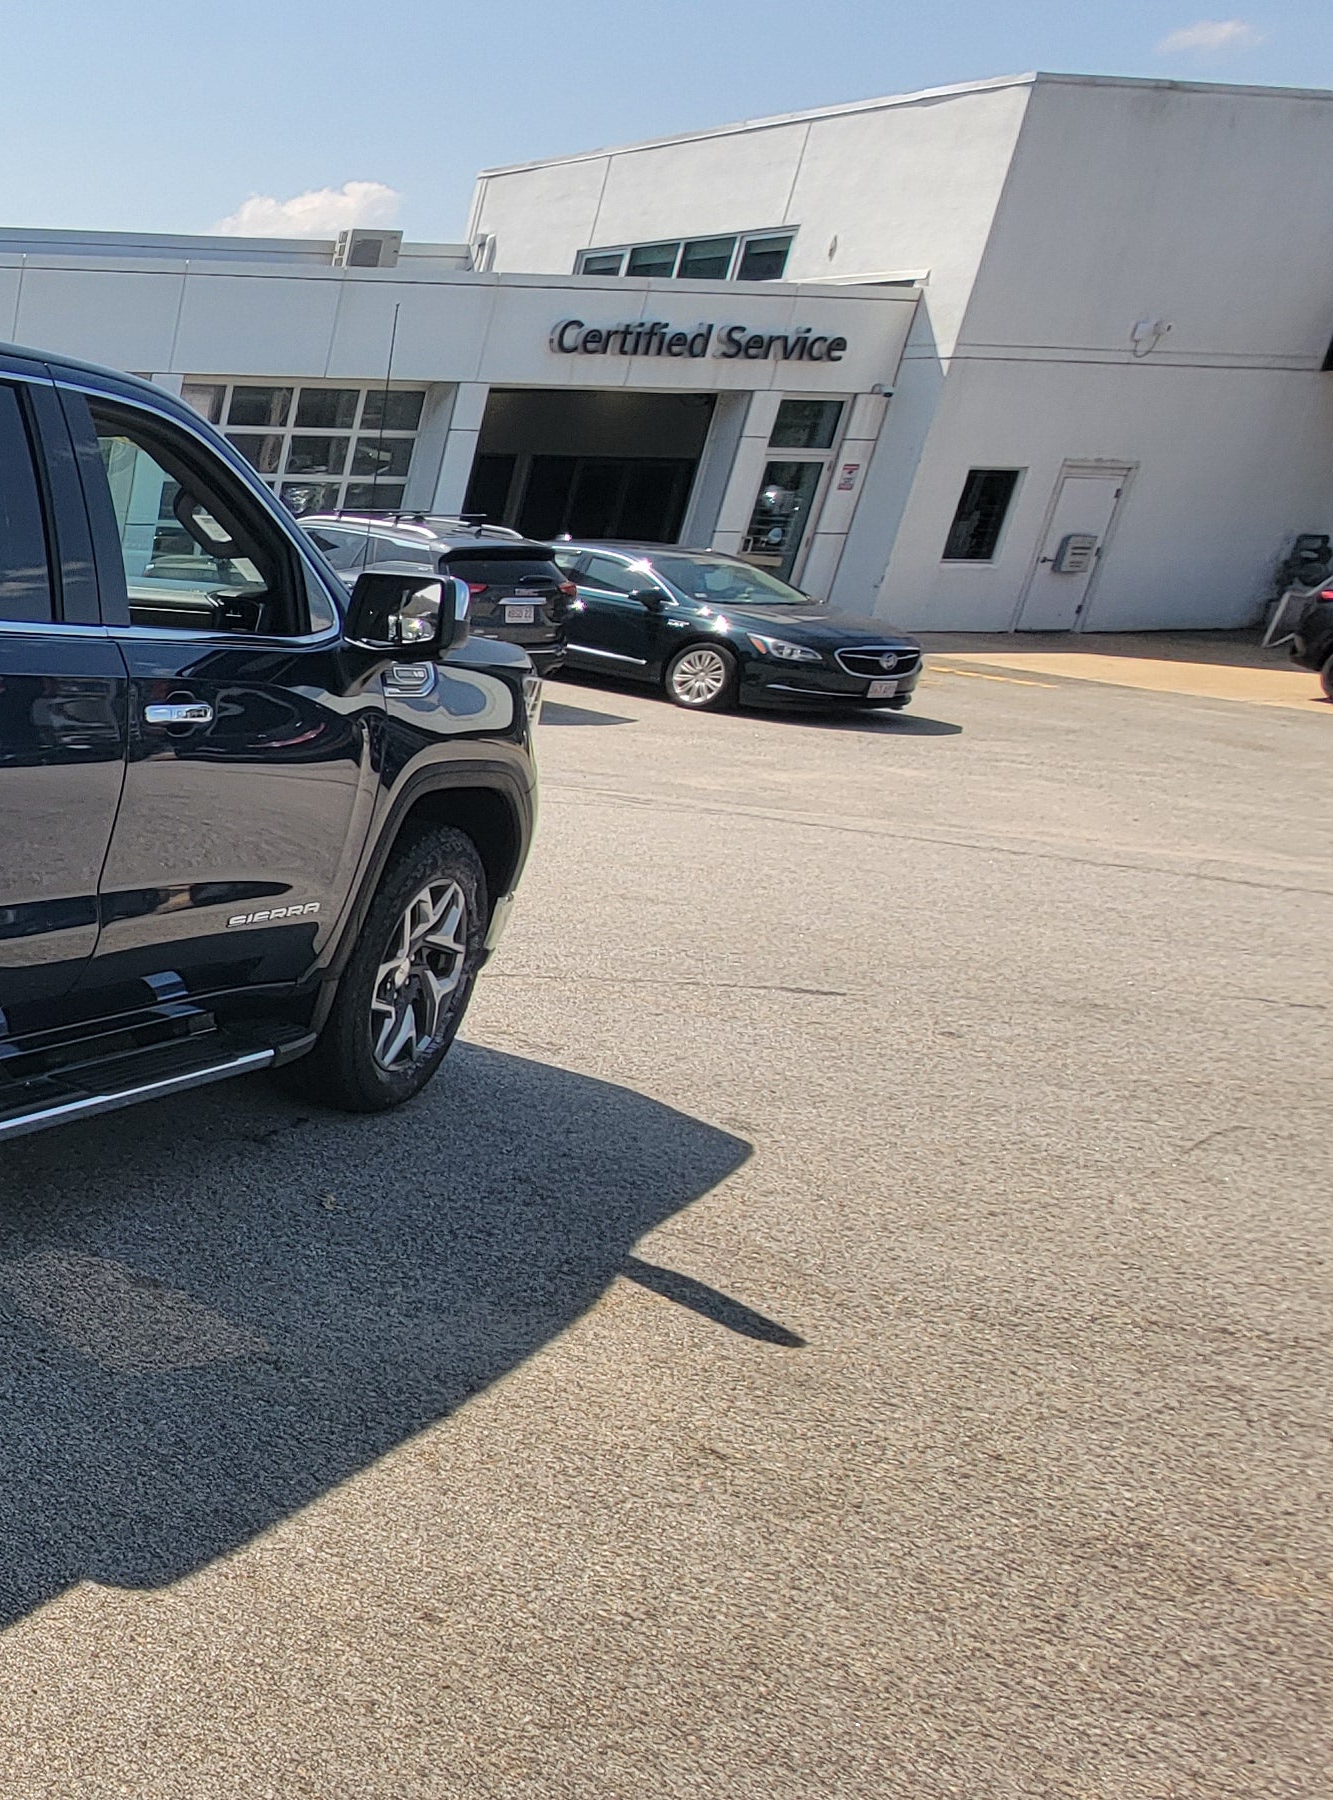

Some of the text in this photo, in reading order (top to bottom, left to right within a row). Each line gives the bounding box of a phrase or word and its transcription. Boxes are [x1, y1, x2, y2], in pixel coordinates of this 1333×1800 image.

[551, 320, 848, 362] Certified Service
[226, 901, 321, 928] SIERRA
